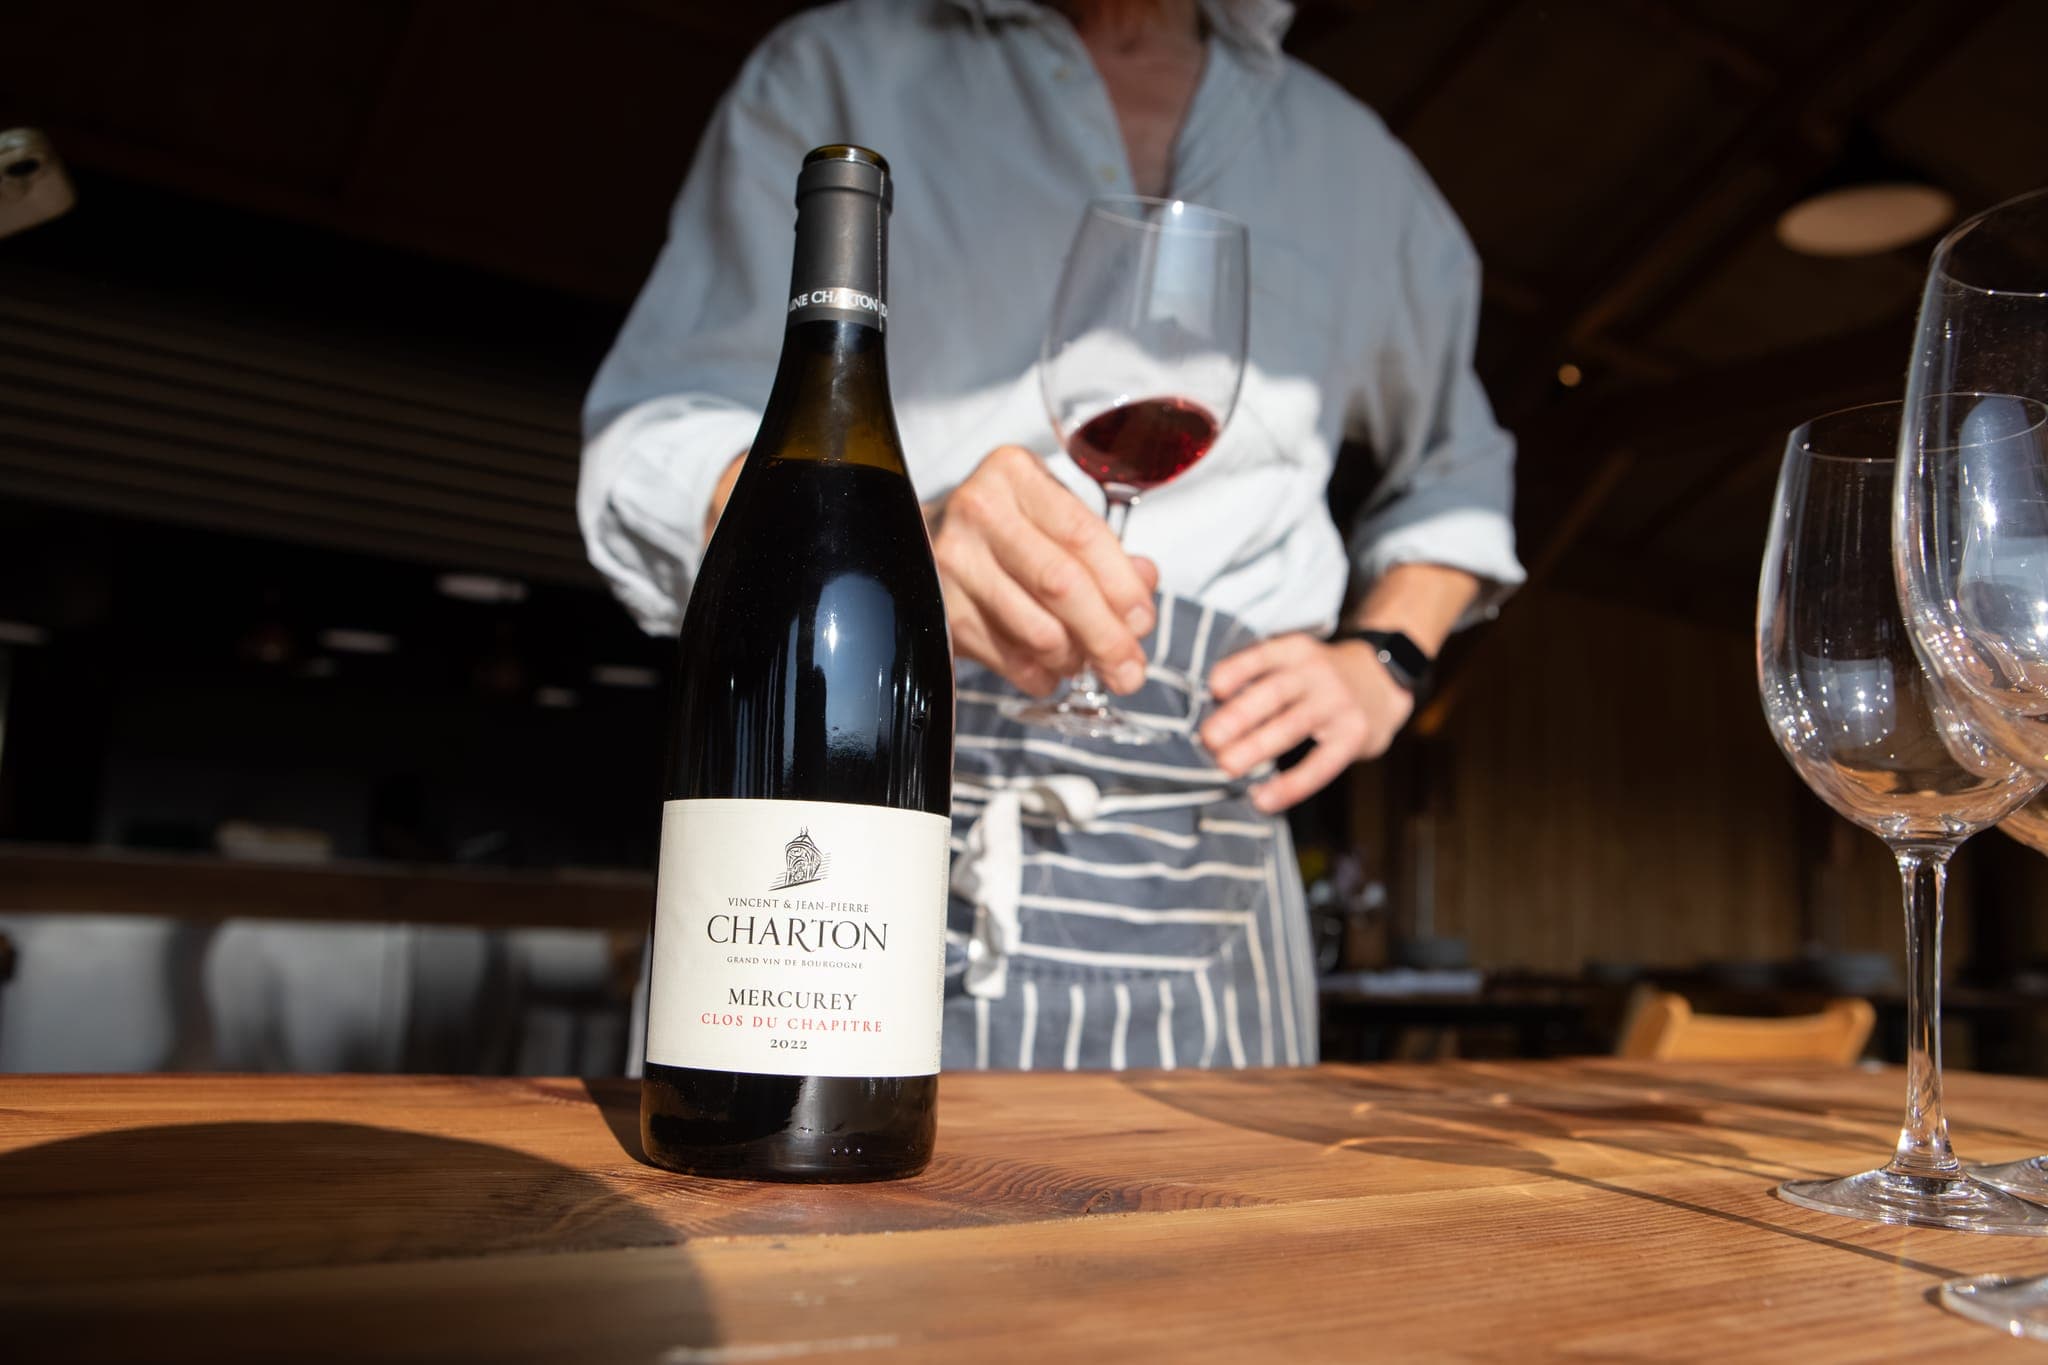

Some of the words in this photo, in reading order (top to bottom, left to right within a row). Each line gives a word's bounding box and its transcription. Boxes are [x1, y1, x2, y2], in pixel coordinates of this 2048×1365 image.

[727, 897, 781, 910] VINCENT
[783, 899, 792, 910] &
[795, 900, 871, 914] JEAN-PIERRE
[706, 914, 889, 953] CHARTON
[726, 956, 760, 966] GRAND
[762, 957, 781, 966] VIN
[784, 959, 798, 968] DE
[801, 959, 864, 970] BOURGOGNE
[727, 987, 859, 1011] MERCUREY
[701, 1012, 743, 1027] CLOS
[752, 1016, 778, 1029] DU
[787, 1017, 883, 1033] CHAPITRE
[769, 1038, 808, 1050] 2022
